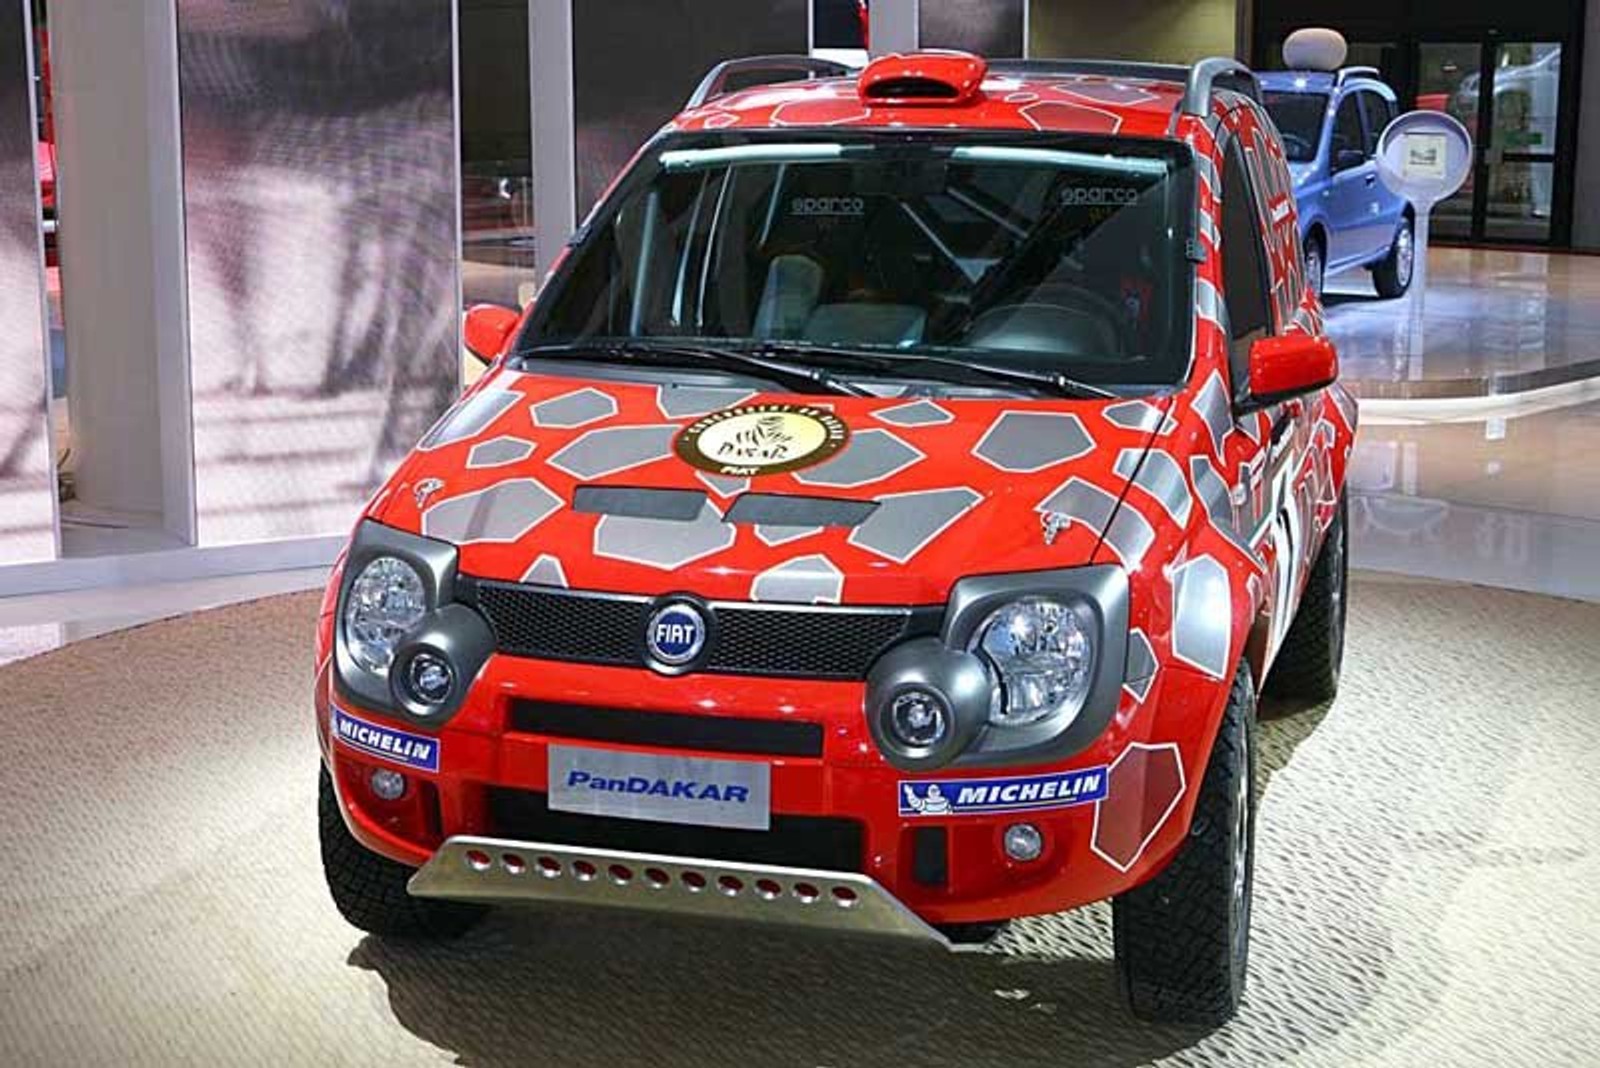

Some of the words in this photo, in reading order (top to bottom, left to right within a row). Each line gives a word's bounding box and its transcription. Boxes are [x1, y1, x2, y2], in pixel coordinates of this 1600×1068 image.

[656, 624, 695, 645] FIAT
[340, 719, 431, 760] MICHELIN
[567, 770, 749, 803] PanDAKAR
[956, 774, 1101, 804] MICHELIN
